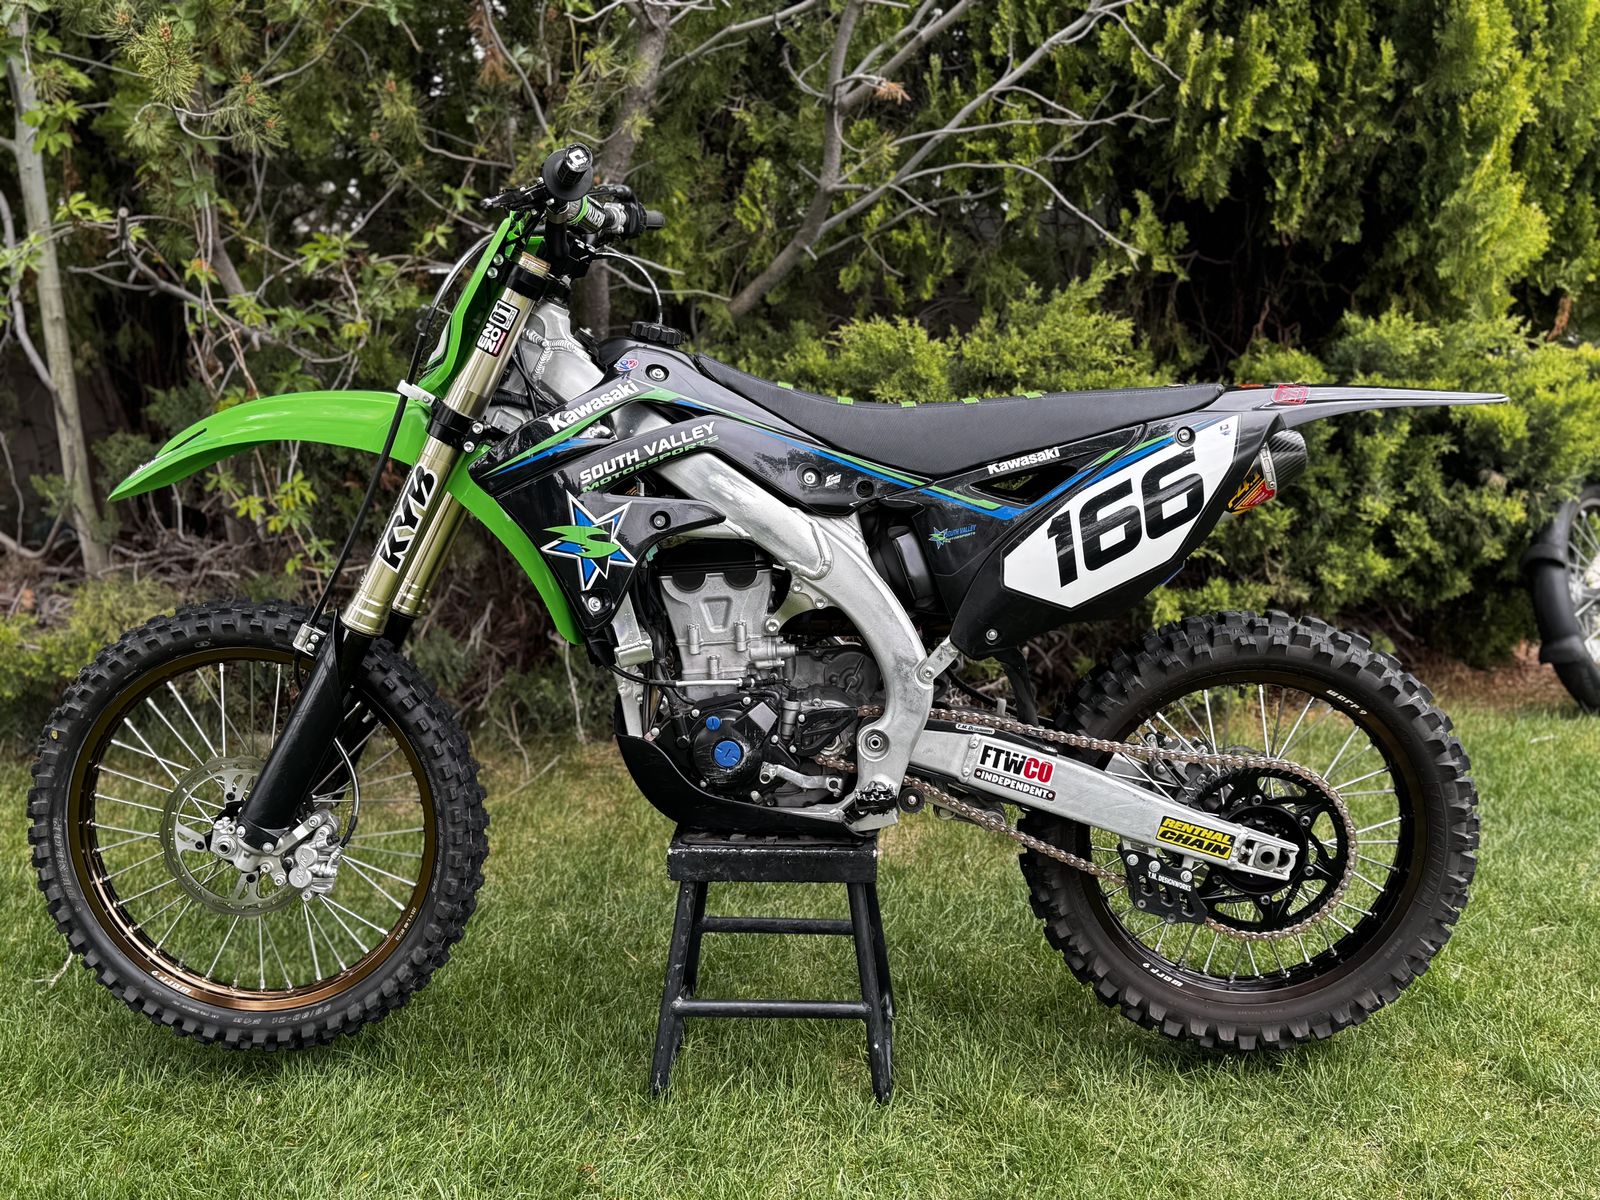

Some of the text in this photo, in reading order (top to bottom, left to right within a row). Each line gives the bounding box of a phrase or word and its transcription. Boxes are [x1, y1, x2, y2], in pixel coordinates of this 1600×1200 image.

[546, 380, 640, 433] Kawasaki
[579, 422, 715, 485] SOUTH VALLEY
[581, 434, 719, 493] MOTORSPORTS
[986, 446, 1061, 475] Kawasaki
[376, 462, 439, 574] KYB
[1046, 446, 1205, 588] 166
[980, 744, 1054, 783] FTWCO
[980, 770, 1049, 799] INDEPENDENT
[1159, 829, 1230, 855] CHAIN
[1162, 818, 1232, 845] RENTHAL
